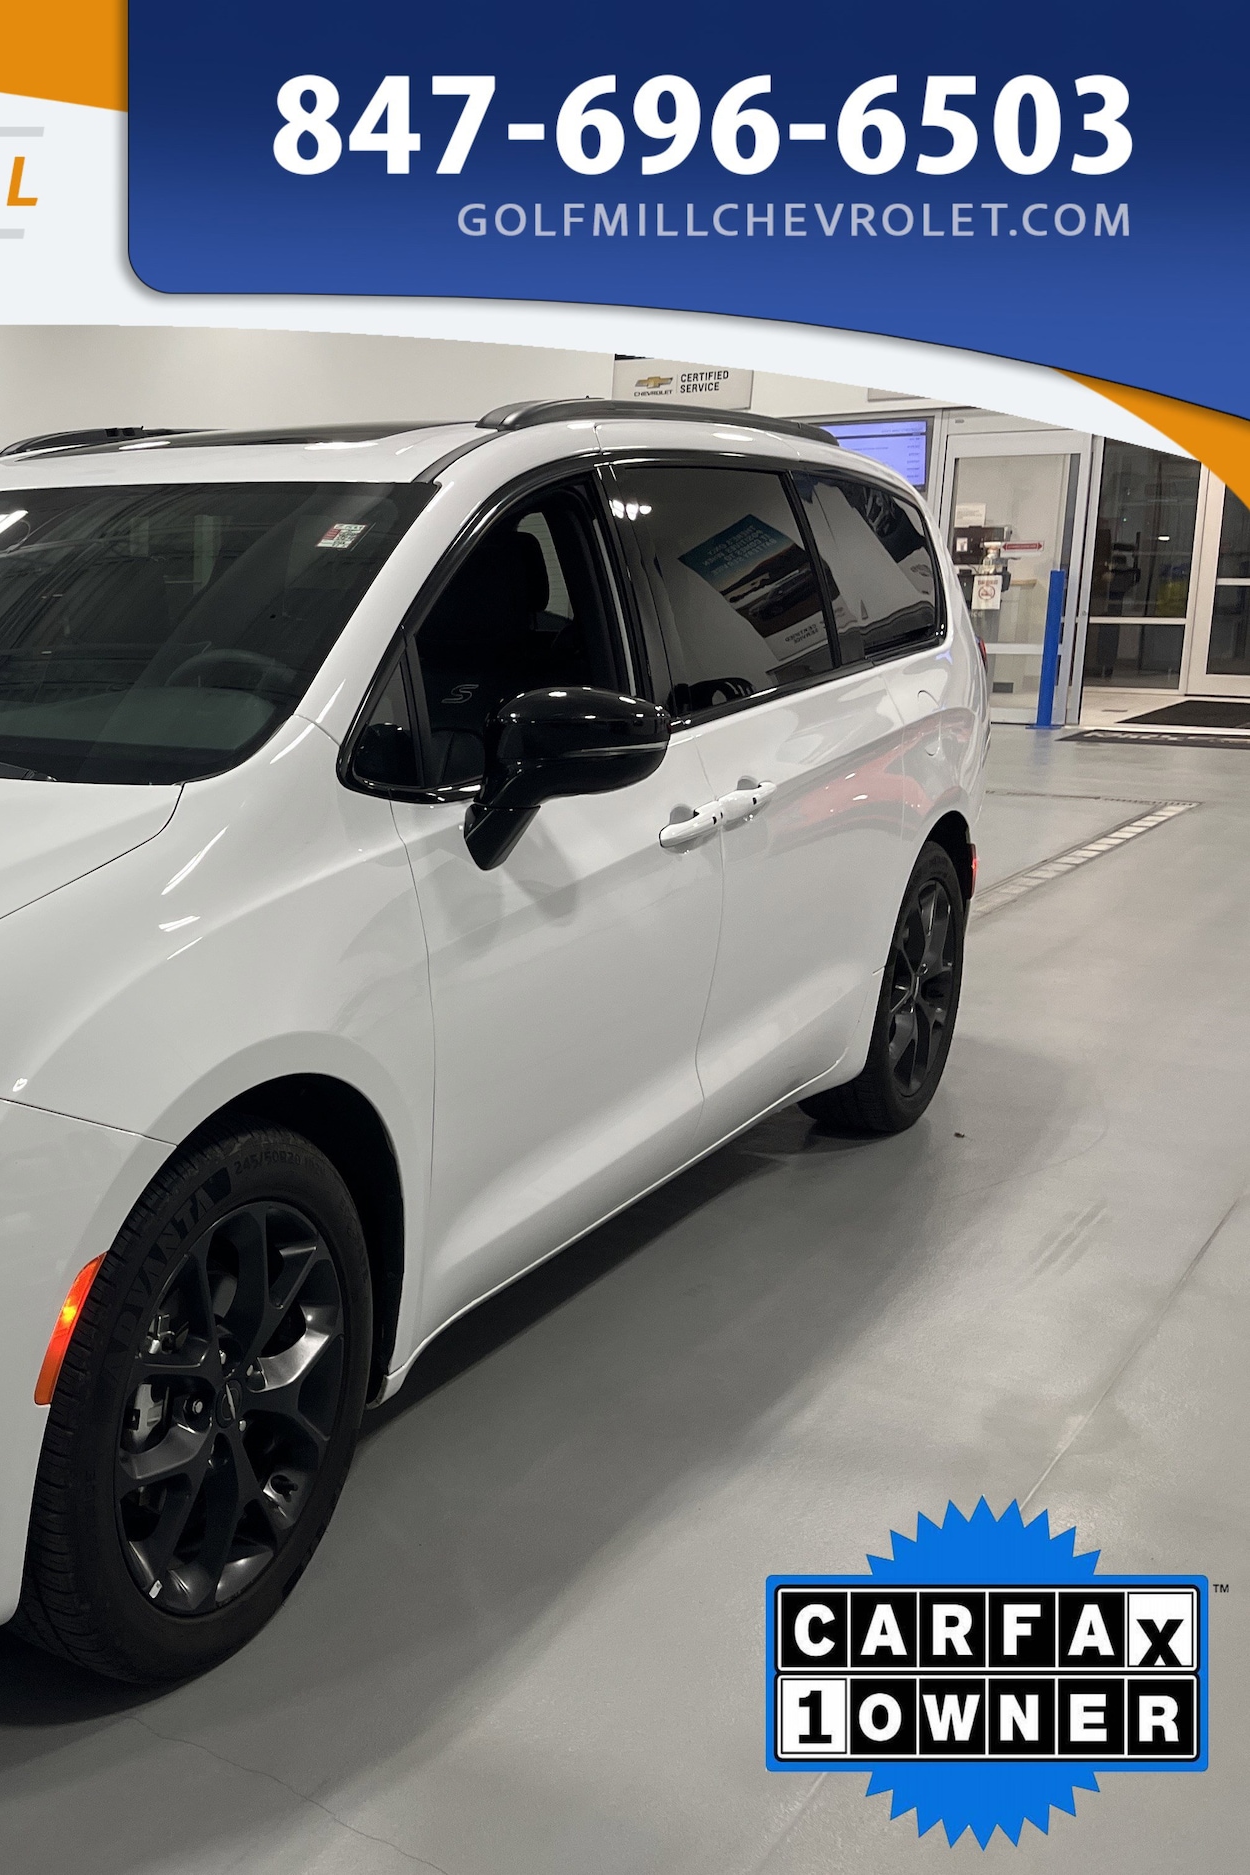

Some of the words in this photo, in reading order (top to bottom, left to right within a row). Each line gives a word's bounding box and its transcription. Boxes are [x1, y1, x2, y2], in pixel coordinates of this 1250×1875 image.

[680, 370, 729, 383] CERTIFIED
[634, 389, 673, 397] CHEVROLET
[680, 382, 720, 393] SERVICE
